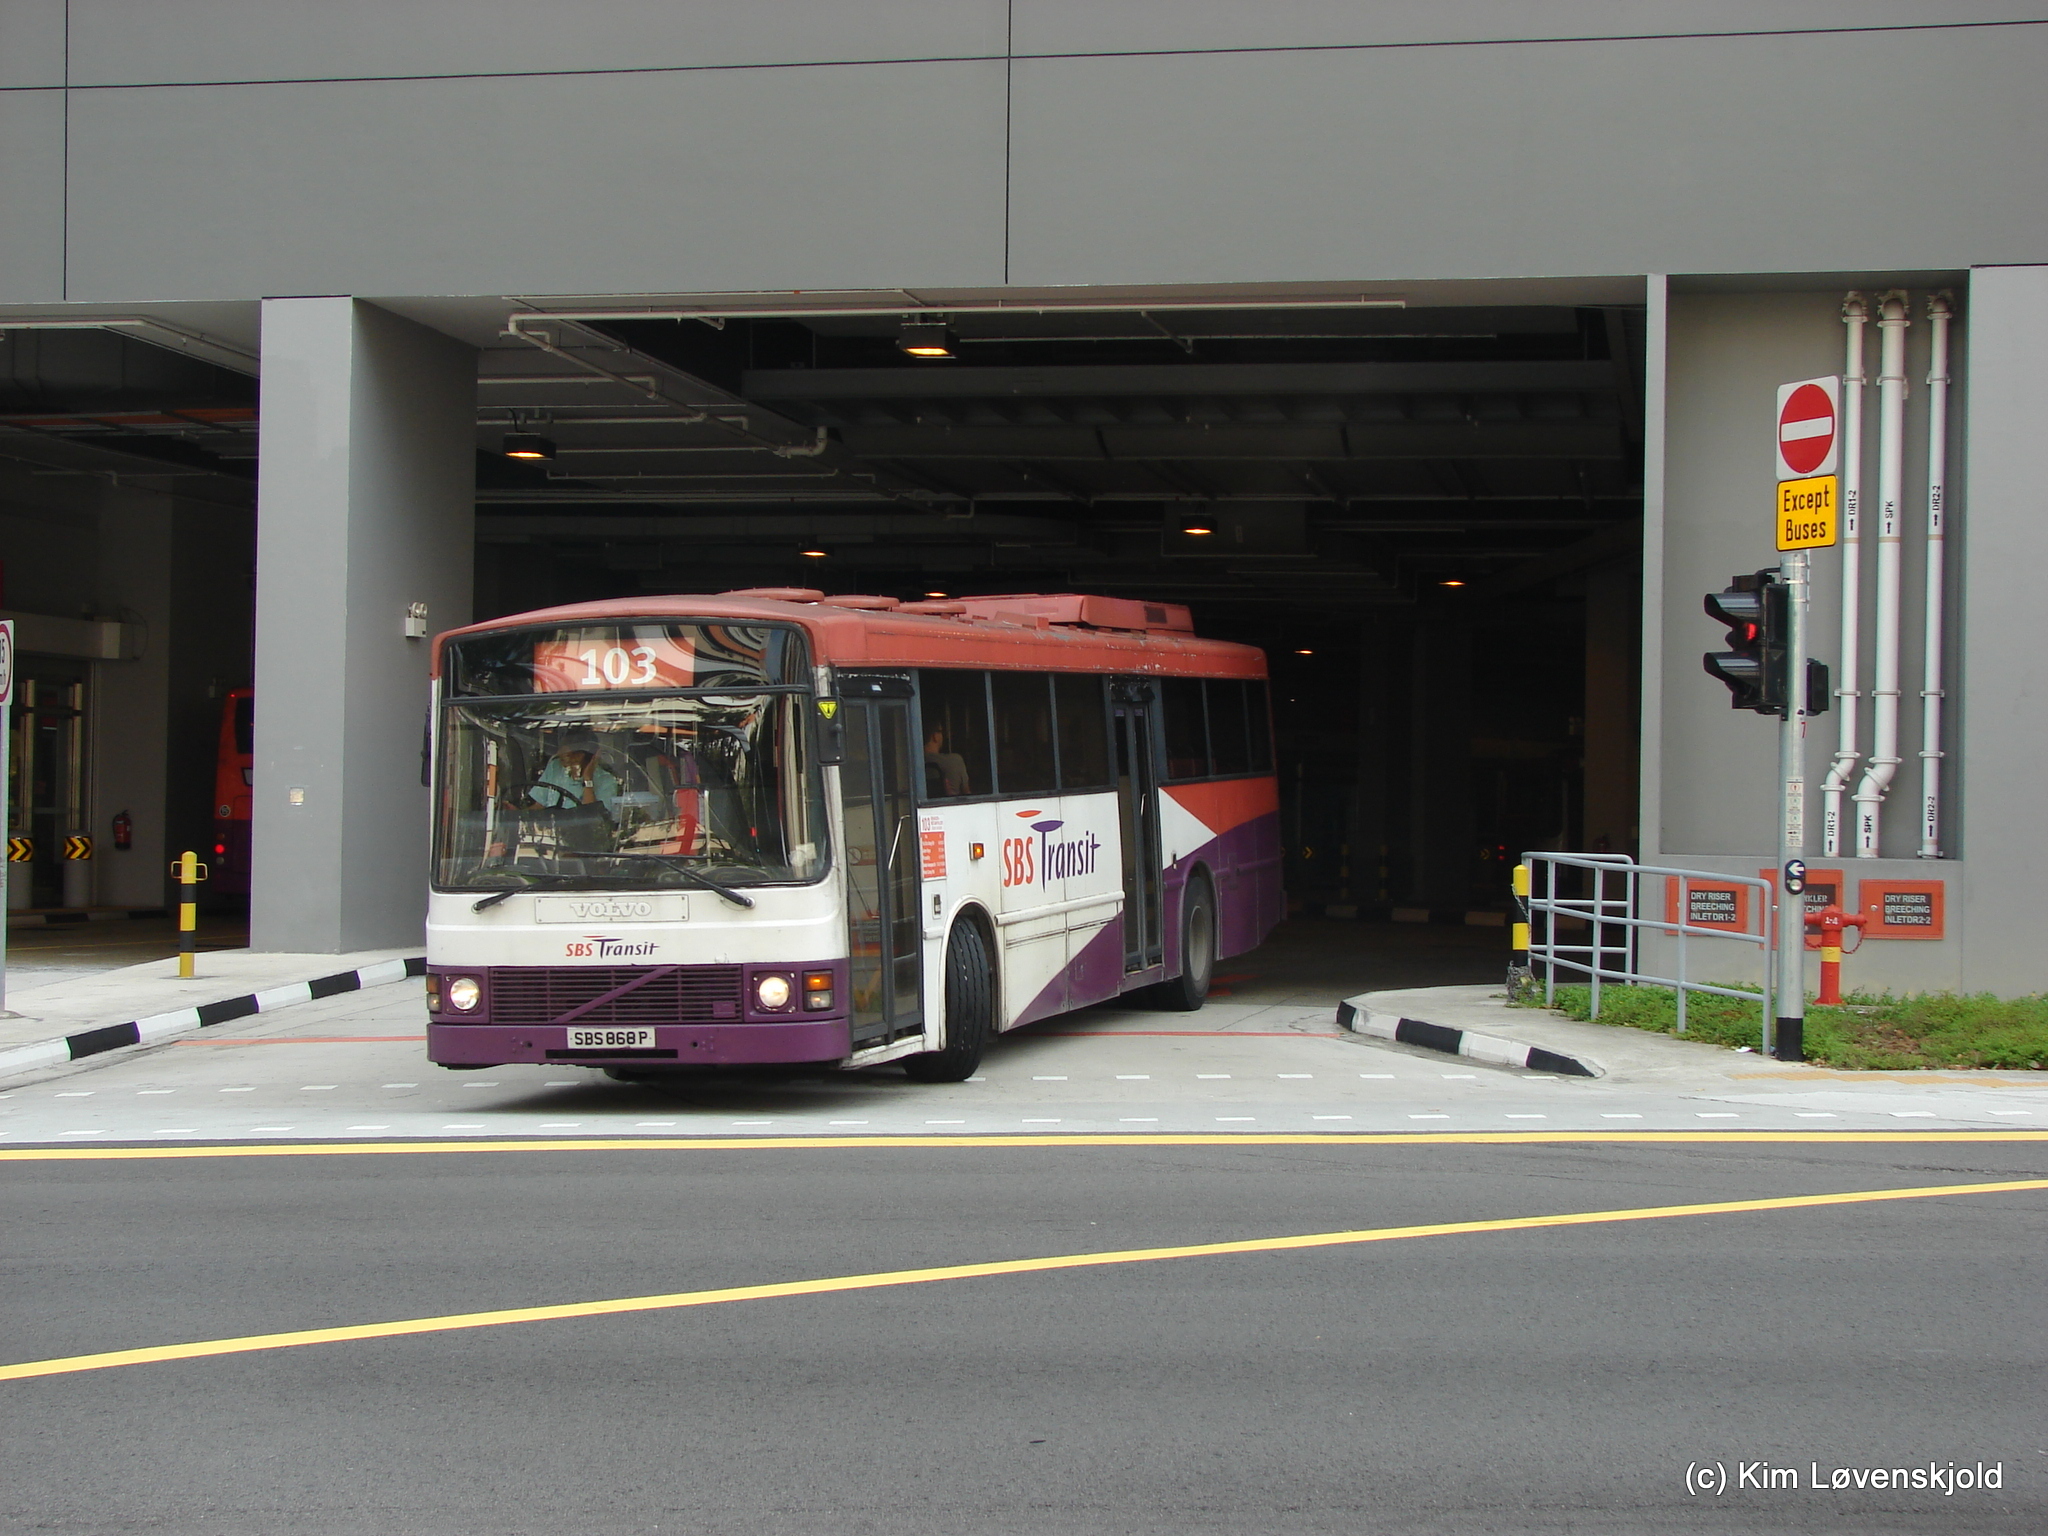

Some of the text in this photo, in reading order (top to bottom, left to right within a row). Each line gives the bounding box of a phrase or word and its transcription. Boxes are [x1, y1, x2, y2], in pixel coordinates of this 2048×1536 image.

[1783, 483, 1830, 515] Except
[1847, 489, 1857, 516] DR1-2
[1931, 485, 1941, 511] DR2-2
[1884, 500, 1894, 519] SPK
[1785, 519, 1827, 543] Buses
[579, 646, 657, 686] 103
[1827, 811, 1837, 837] DR1-2
[1864, 815, 1873, 834] SPK
[1003, 836, 1035, 888] SBS
[1030, 820, 1101, 893] Transit
[1690, 892, 1731, 901] DRY RISER
[1690, 902, 1735, 911] BREECHING
[1885, 895, 1926, 904] DRY RISER
[570, 902, 652, 918] VOLVO
[1690, 912, 1736, 922] INLET DR1-2
[1885, 905, 1931, 914] BREECHING
[565, 938, 661, 959] SBS Transit
